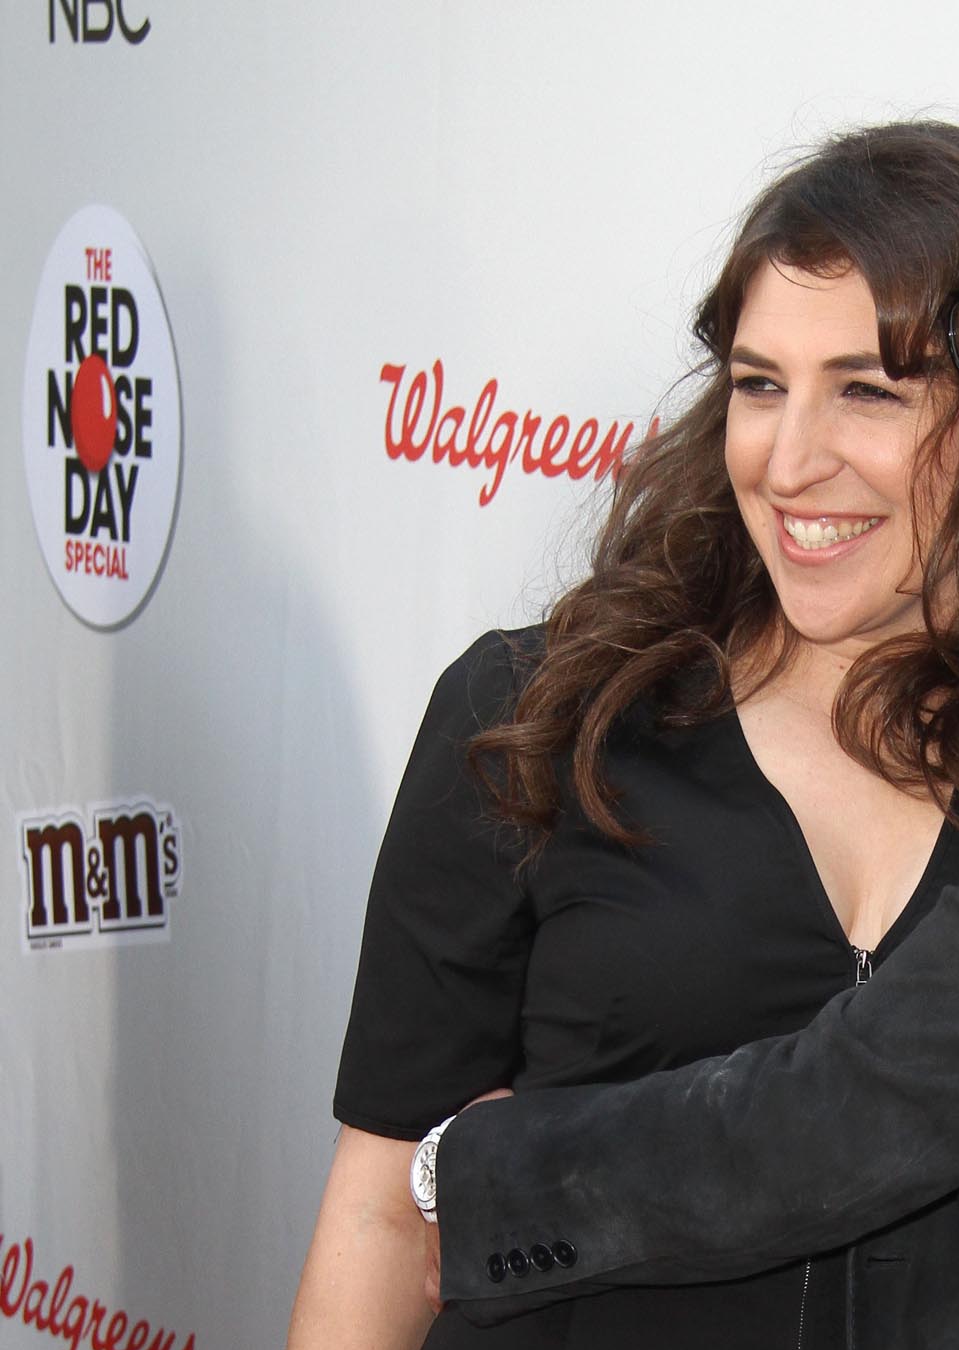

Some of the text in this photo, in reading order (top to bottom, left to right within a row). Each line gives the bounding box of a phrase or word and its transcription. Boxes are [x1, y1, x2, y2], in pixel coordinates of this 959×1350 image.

[85, 248, 112, 282] THE
[65, 284, 139, 368] RED
[65, 456, 139, 542] DAY
[65, 539, 129, 580] SPECIAL
